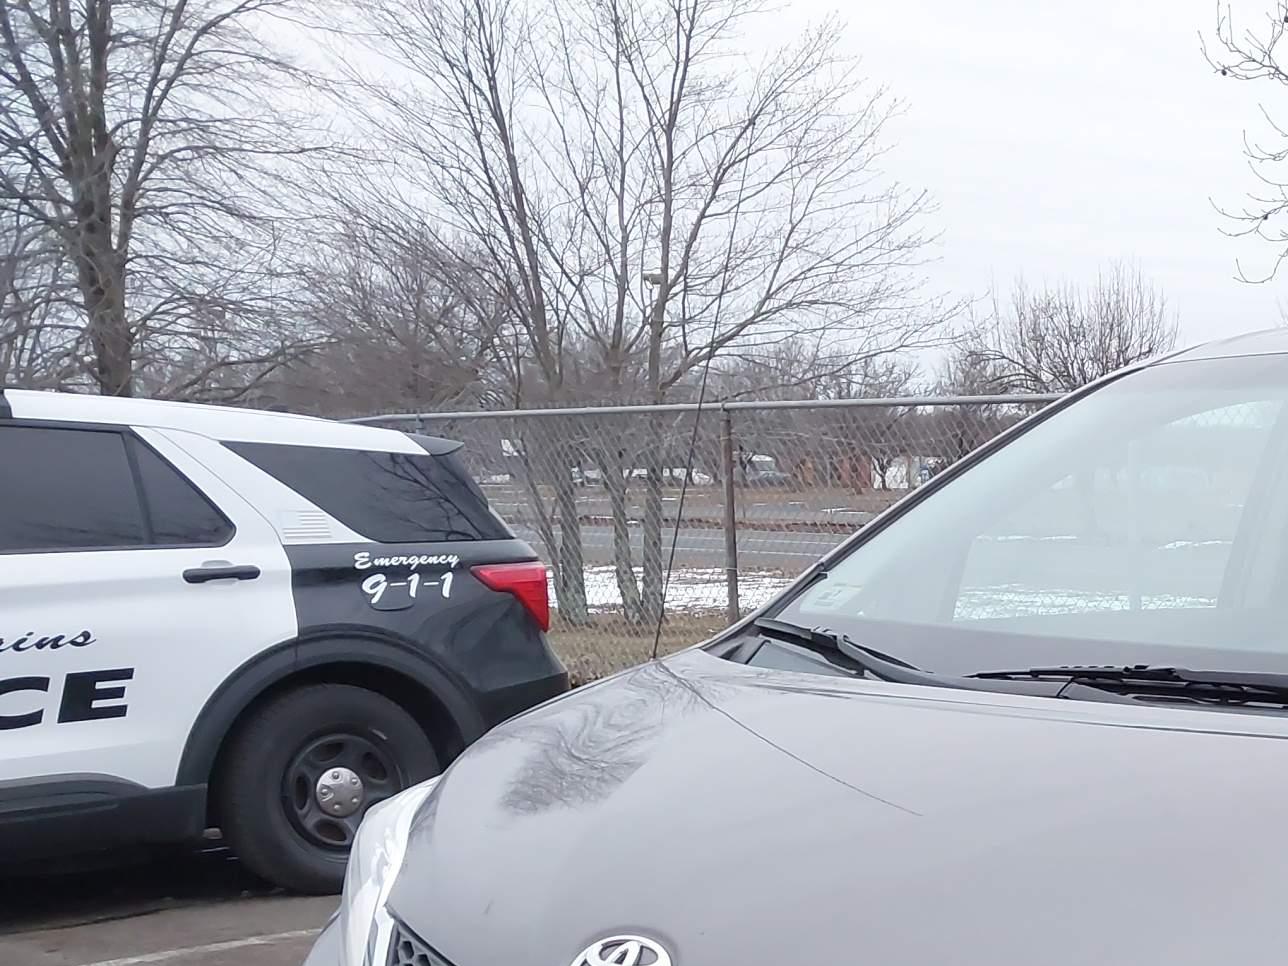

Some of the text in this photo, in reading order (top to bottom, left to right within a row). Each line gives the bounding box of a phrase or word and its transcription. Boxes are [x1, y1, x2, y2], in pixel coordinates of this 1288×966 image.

[353, 551, 460, 571] Emergency
[361, 571, 454, 604] 9-1-1
[0, 667, 135, 731] CE
